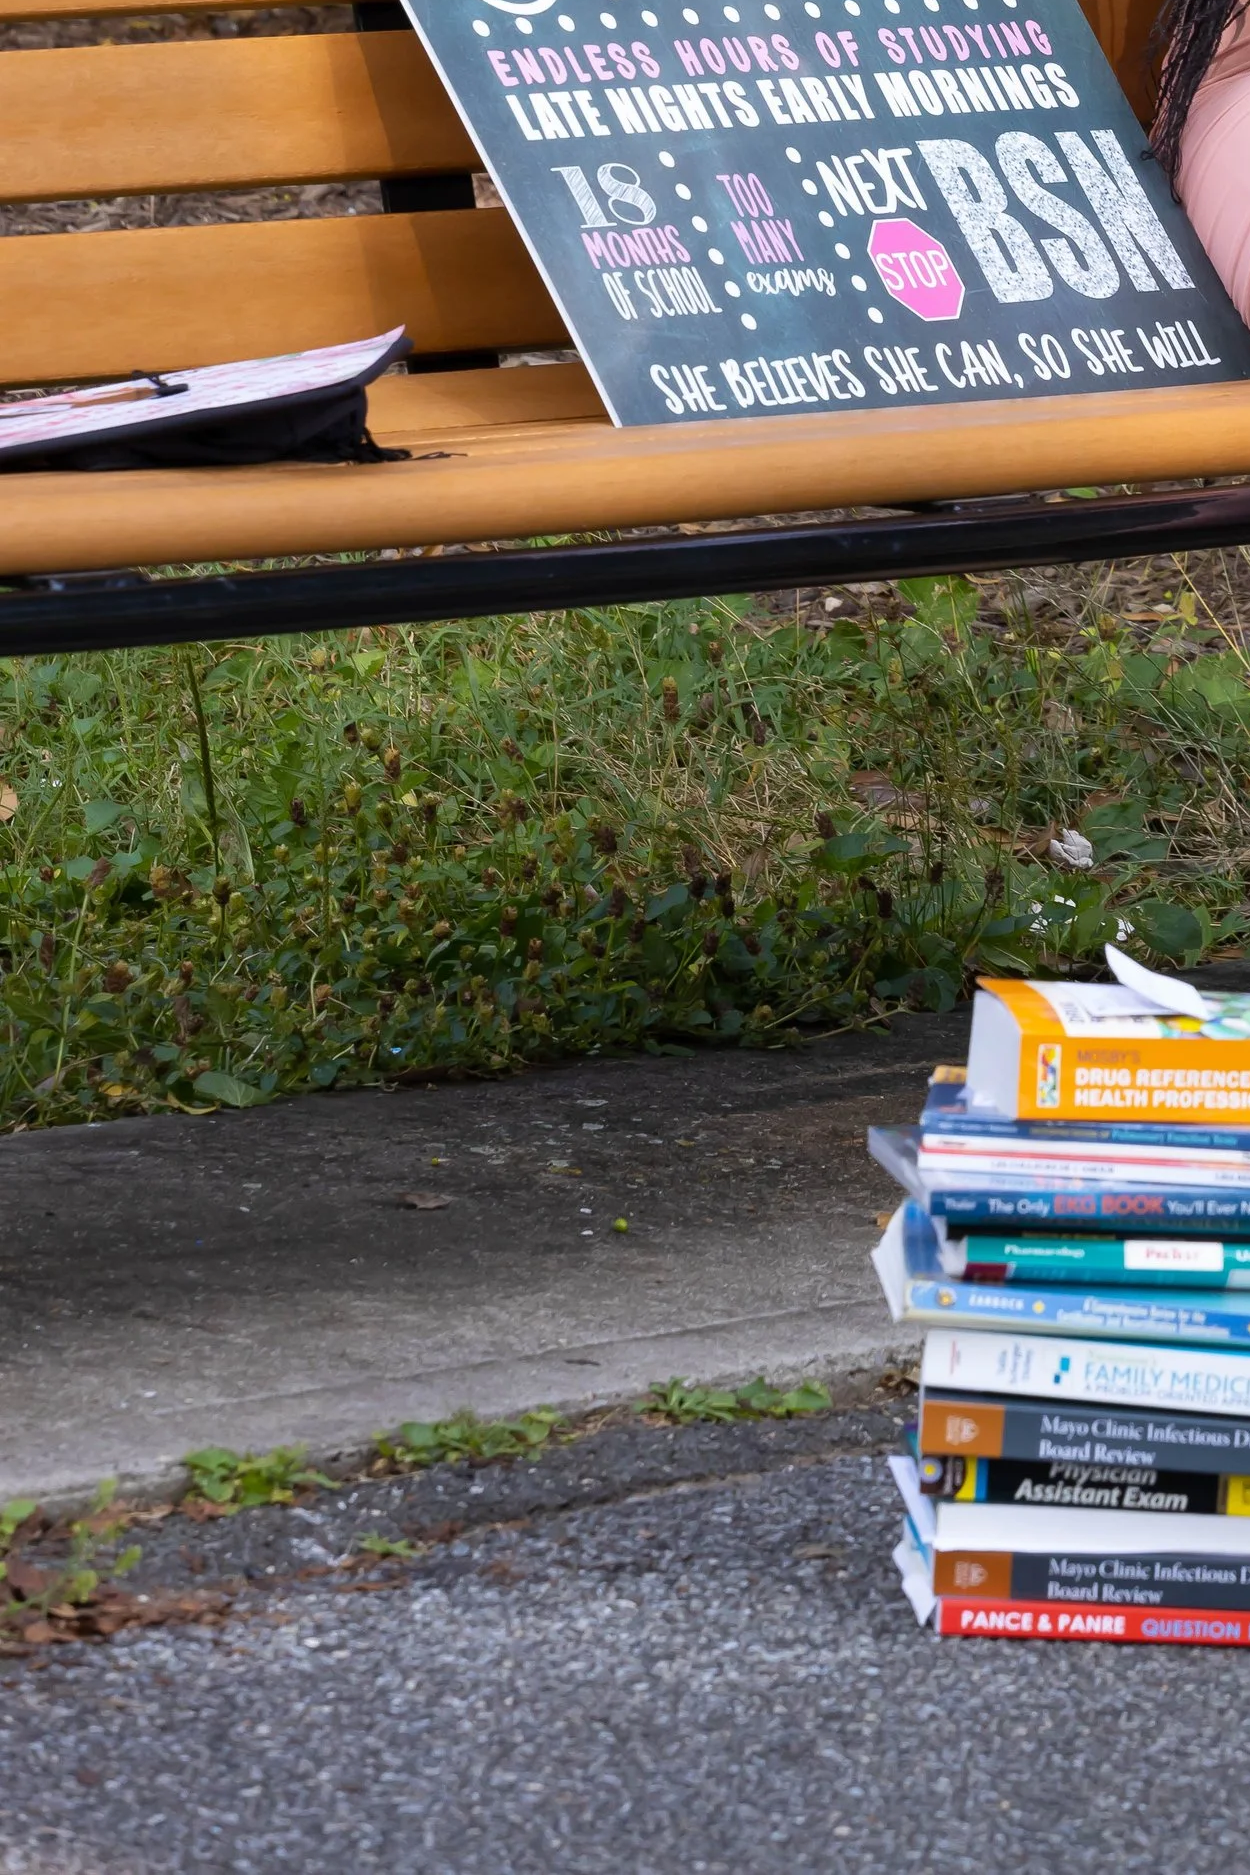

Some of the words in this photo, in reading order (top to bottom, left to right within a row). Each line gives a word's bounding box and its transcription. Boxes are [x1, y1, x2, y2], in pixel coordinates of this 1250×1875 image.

[486, 40, 661, 88] ENDLESS
[672, 33, 800, 77] HOURS
[815, 30, 860, 69] OF
[877, 19, 1054, 65] STUDYING
[505, 89, 612, 142] LATE
[604, 80, 760, 134] NIGHTS
[755, 74, 876, 126] EARLY
[873, 62, 1081, 119] MORNINGS
[550, 162, 658, 229] 18
[716, 172, 776, 218] TOO
[815, 147, 929, 217] NEXT
[914, 128, 1197, 305] BSN
[580, 224, 692, 270] MONTHS
[730, 218, 805, 265] MANY
[746, 267, 837, 298] exams
[876, 249, 949, 292] STOP
[601, 271, 639, 321] OF
[634, 266, 724, 319] SCHOOL
[650, 364, 728, 415] SHE
[719, 348, 866, 409] BELIEVES
[863, 345, 940, 395] SHE
[1017, 332, 1072, 381] SO
[1070, 327, 1145, 376] SHE
[1136, 319, 1222, 369] WILL
[1076, 1048, 1141, 1065] MOSBY'S
[1075, 1067, 1132, 1087] DRUG
[1075, 1088, 1148, 1107] HEALTH
[988, 1197, 1014, 1215] The
[1016, 1198, 1051, 1218] Only
[1053, 1194, 1097, 1215] EKG
[1101, 1194, 1165, 1216] BOOK
[1166, 1199, 1204, 1217] You'll
[1206, 1201, 1237, 1217] Ever
[1083, 1361, 1164, 1387] FAMILY
[1040, 1414, 1089, 1441] Mayo
[1090, 1417, 1143, 1440] Clinic
[1146, 1421, 1231, 1446] Infectious
[1039, 1439, 1091, 1460] Board
[1093, 1442, 1156, 1465] Review
[1048, 1461, 1158, 1486] Physician
[1013, 1478, 1120, 1508] Assistant
[1121, 1487, 1189, 1513] Exam
[1048, 1557, 1097, 1582] Mayo
[1098, 1560, 1149, 1580] Clinic
[1153, 1562, 1237, 1585] Infectious
[1047, 1581, 1098, 1601] Board
[1101, 1584, 1163, 1605] Review
[960, 1609, 1033, 1632] PANCE
[1036, 1613, 1053, 1633] &
[1057, 1614, 1127, 1635] PANRE
[1140, 1618, 1241, 1640] QUESTION
